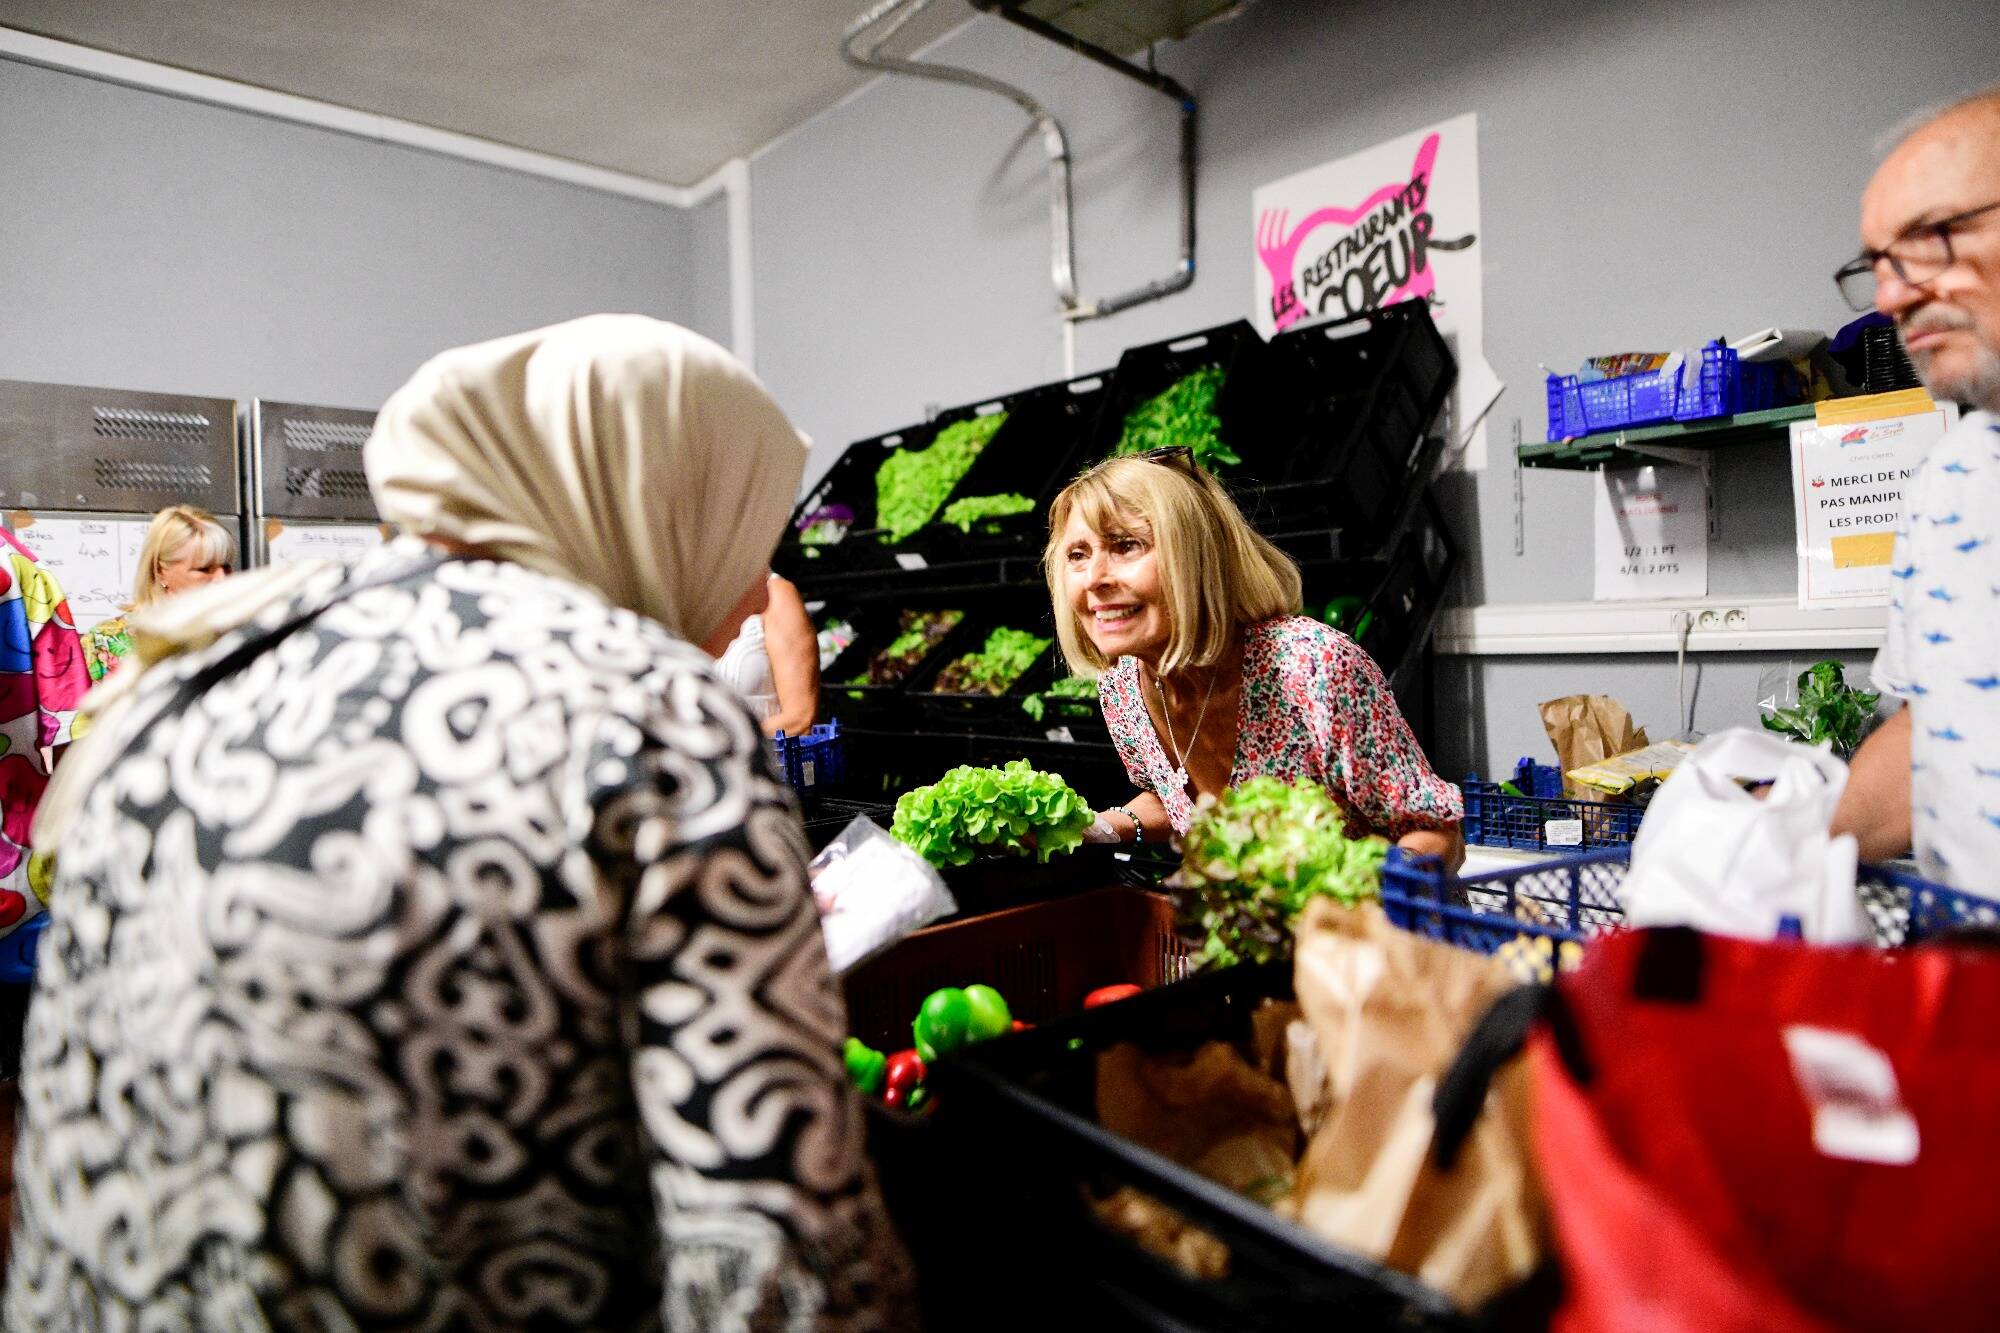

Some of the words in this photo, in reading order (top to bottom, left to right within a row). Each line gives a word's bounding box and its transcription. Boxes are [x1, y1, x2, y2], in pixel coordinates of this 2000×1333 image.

[1271, 281, 1297, 323] LES
[1302, 172, 1427, 296] RESTAURANTS
[1831, 473, 1873, 488] MERCI
[1878, 471, 1896, 483] DE
[1820, 497, 1845, 509] PAS
[1829, 516, 1851, 528] LES
[1855, 512, 1899, 526] PROD
[1658, 562, 1680, 574] PTS
